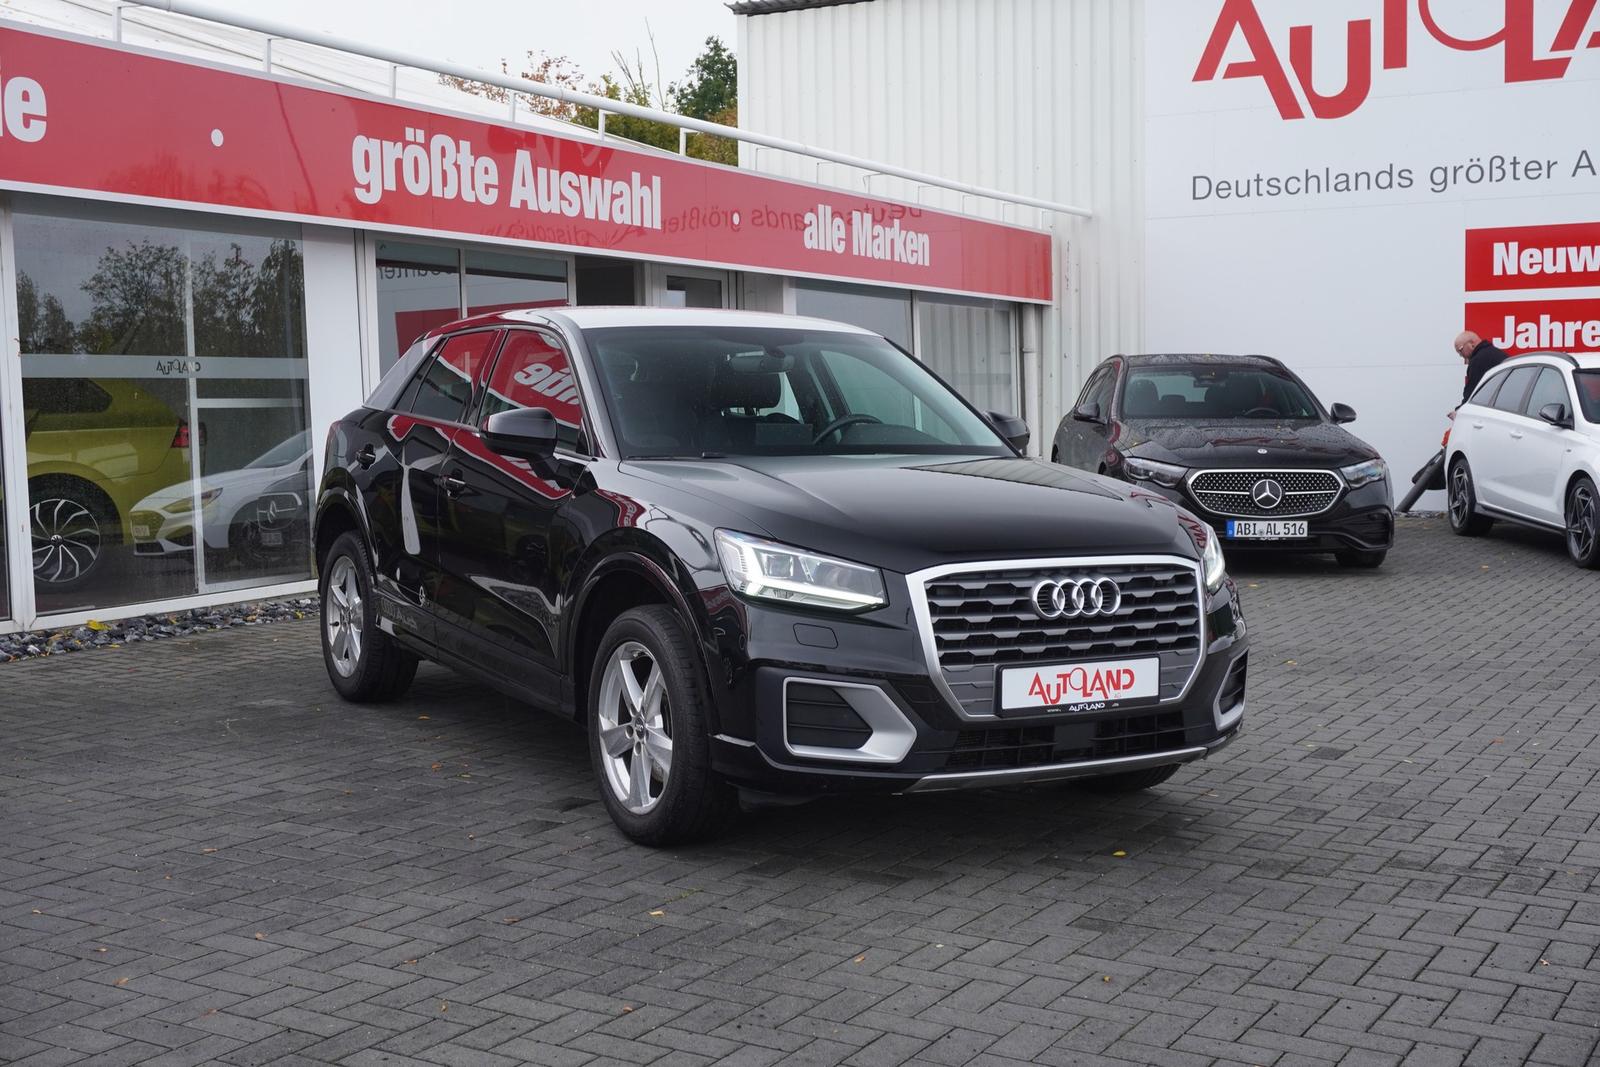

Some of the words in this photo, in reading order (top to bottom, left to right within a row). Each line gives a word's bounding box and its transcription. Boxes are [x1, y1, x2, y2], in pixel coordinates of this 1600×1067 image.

[0, 75, 47, 143] e
[351, 127, 499, 205] größte
[509, 149, 662, 230] Auswahl
[803, 204, 846, 254] alle
[852, 210, 930, 266] Marken
[1192, 163, 1414, 201] Deutschlands
[1430, 155, 1558, 193] größter
[1493, 241, 1600, 276] Neuw
[1492, 314, 1600, 350] Jahre
[1236, 523, 1257, 536] ABI
[1266, 522, 1280, 536] AL
[1283, 522, 1305, 536] 516
[1028, 667, 1136, 705] AUTOLAND
